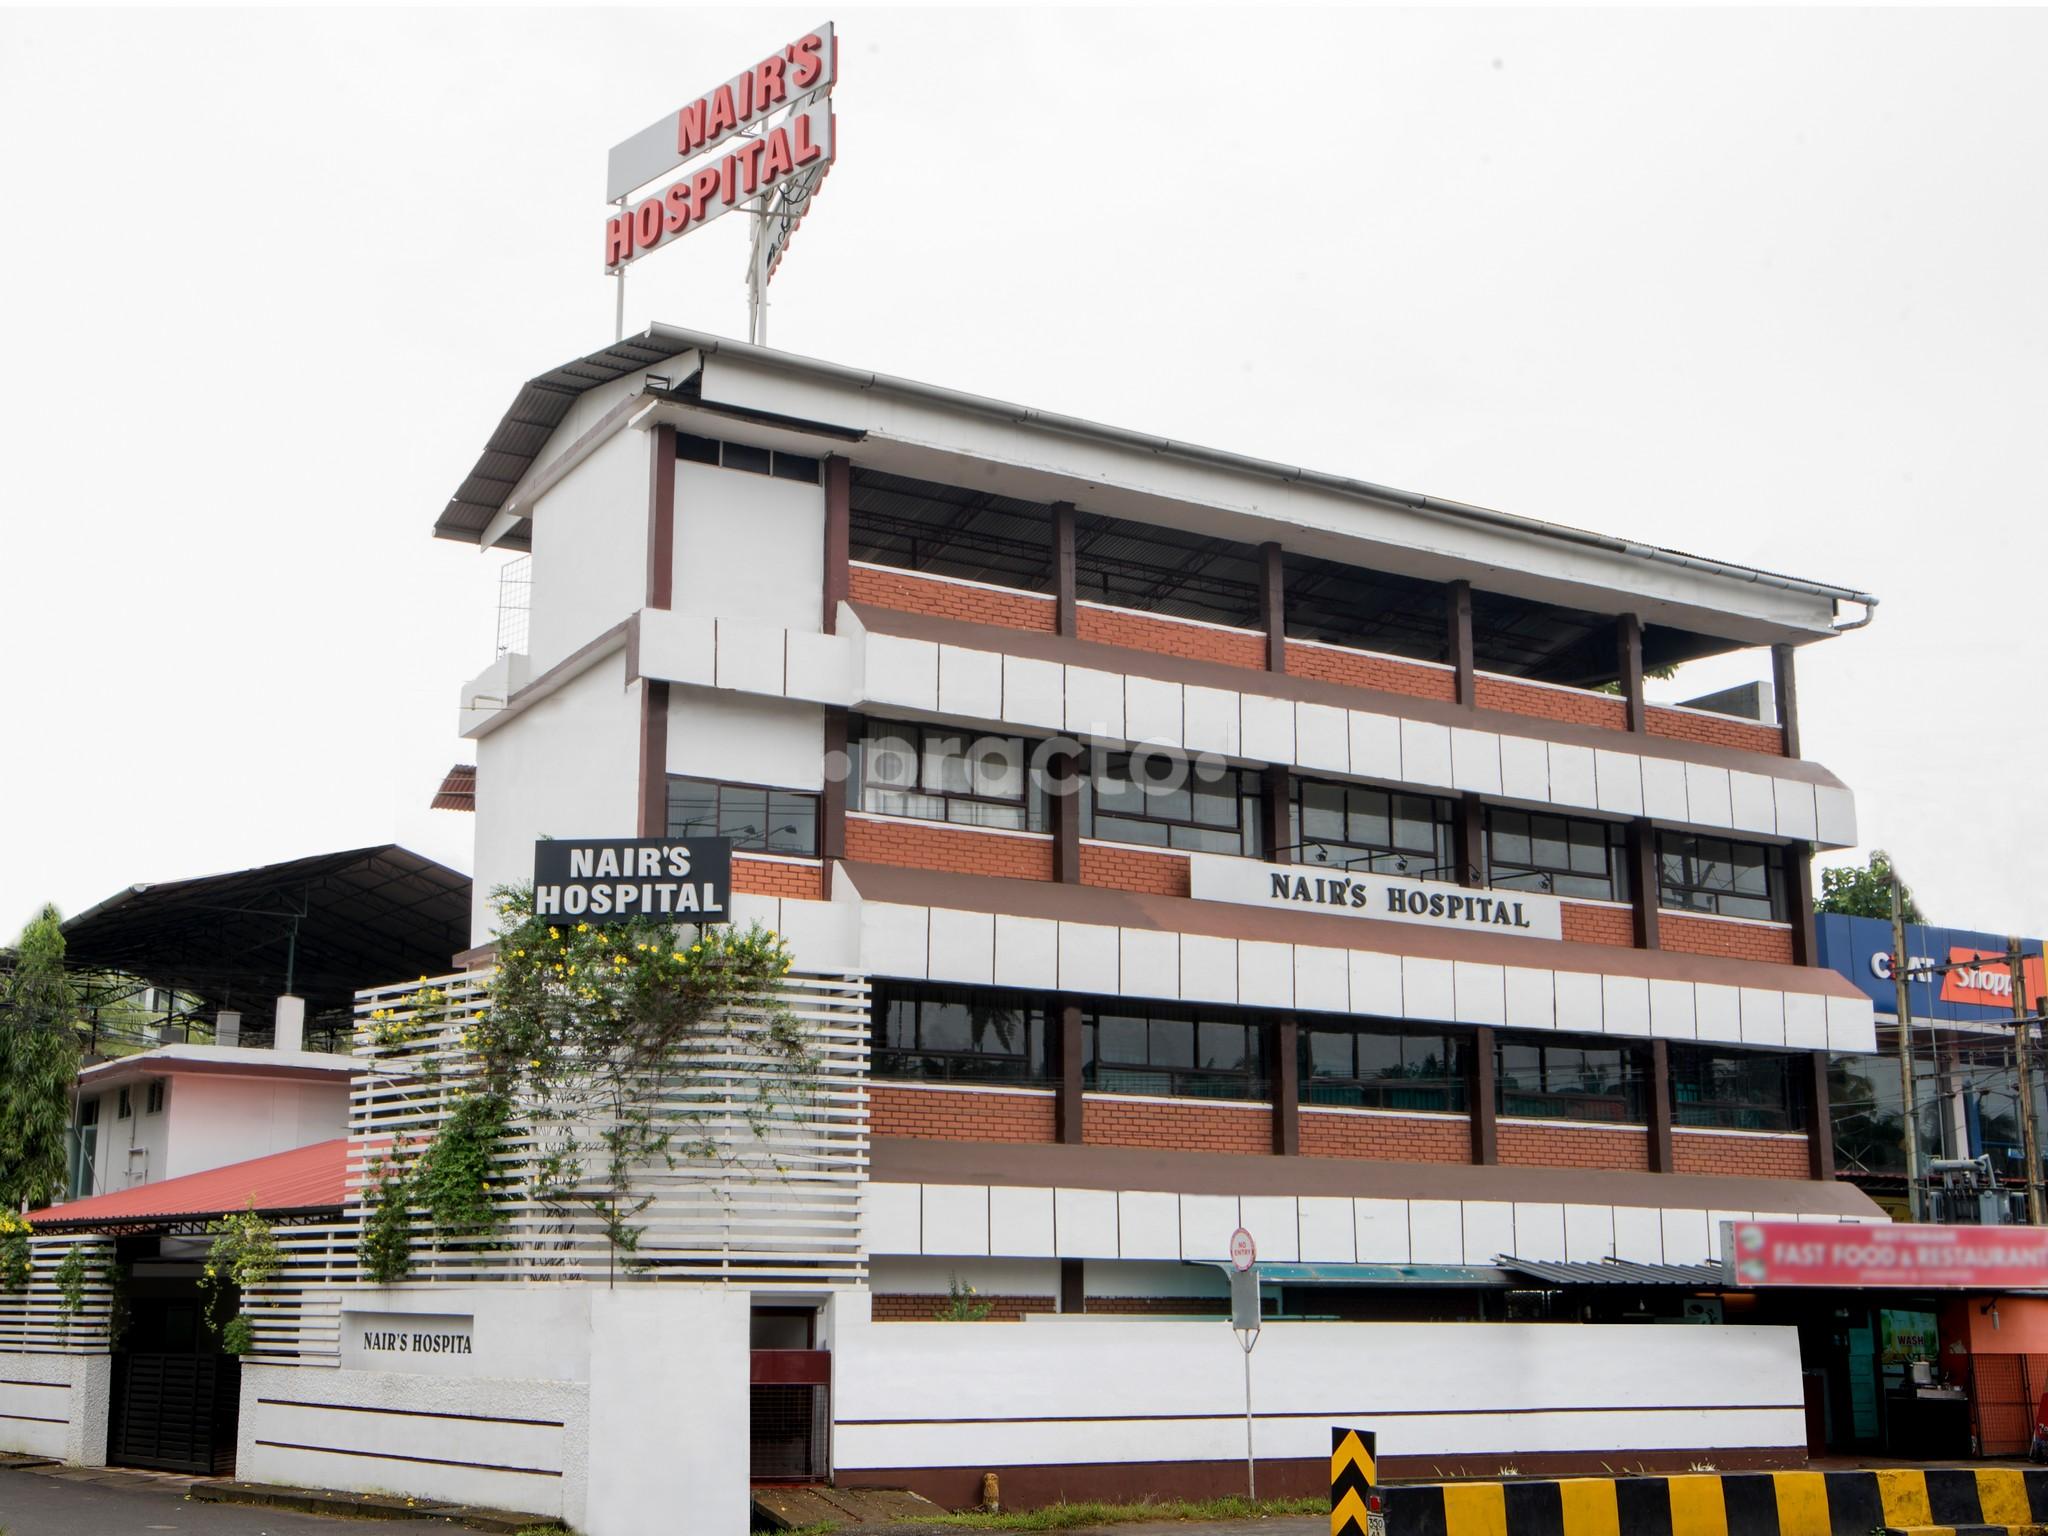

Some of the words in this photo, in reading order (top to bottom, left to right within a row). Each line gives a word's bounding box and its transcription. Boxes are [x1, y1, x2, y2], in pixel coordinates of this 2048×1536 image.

[677, 33, 822, 156] NAIR'S
[606, 113, 821, 267] HOSPITAL
[570, 846, 691, 878] NAIR'S
[536, 882, 723, 915] HOSPITAL
[1270, 873, 1367, 908] NAIR'S
[1388, 887, 1530, 928] HOSPITAL
[1955, 964, 2013, 997] Shopp
[1234, 1248, 1251, 1256] ENTRY
[1238, 1241, 1247, 1249] NO
[1831, 1244, 1896, 1269] FOOD
[364, 1332, 408, 1352] NAIR'S
[413, 1333, 472, 1354] HOSPITA
[1897, 1335, 1924, 1345] WASH
